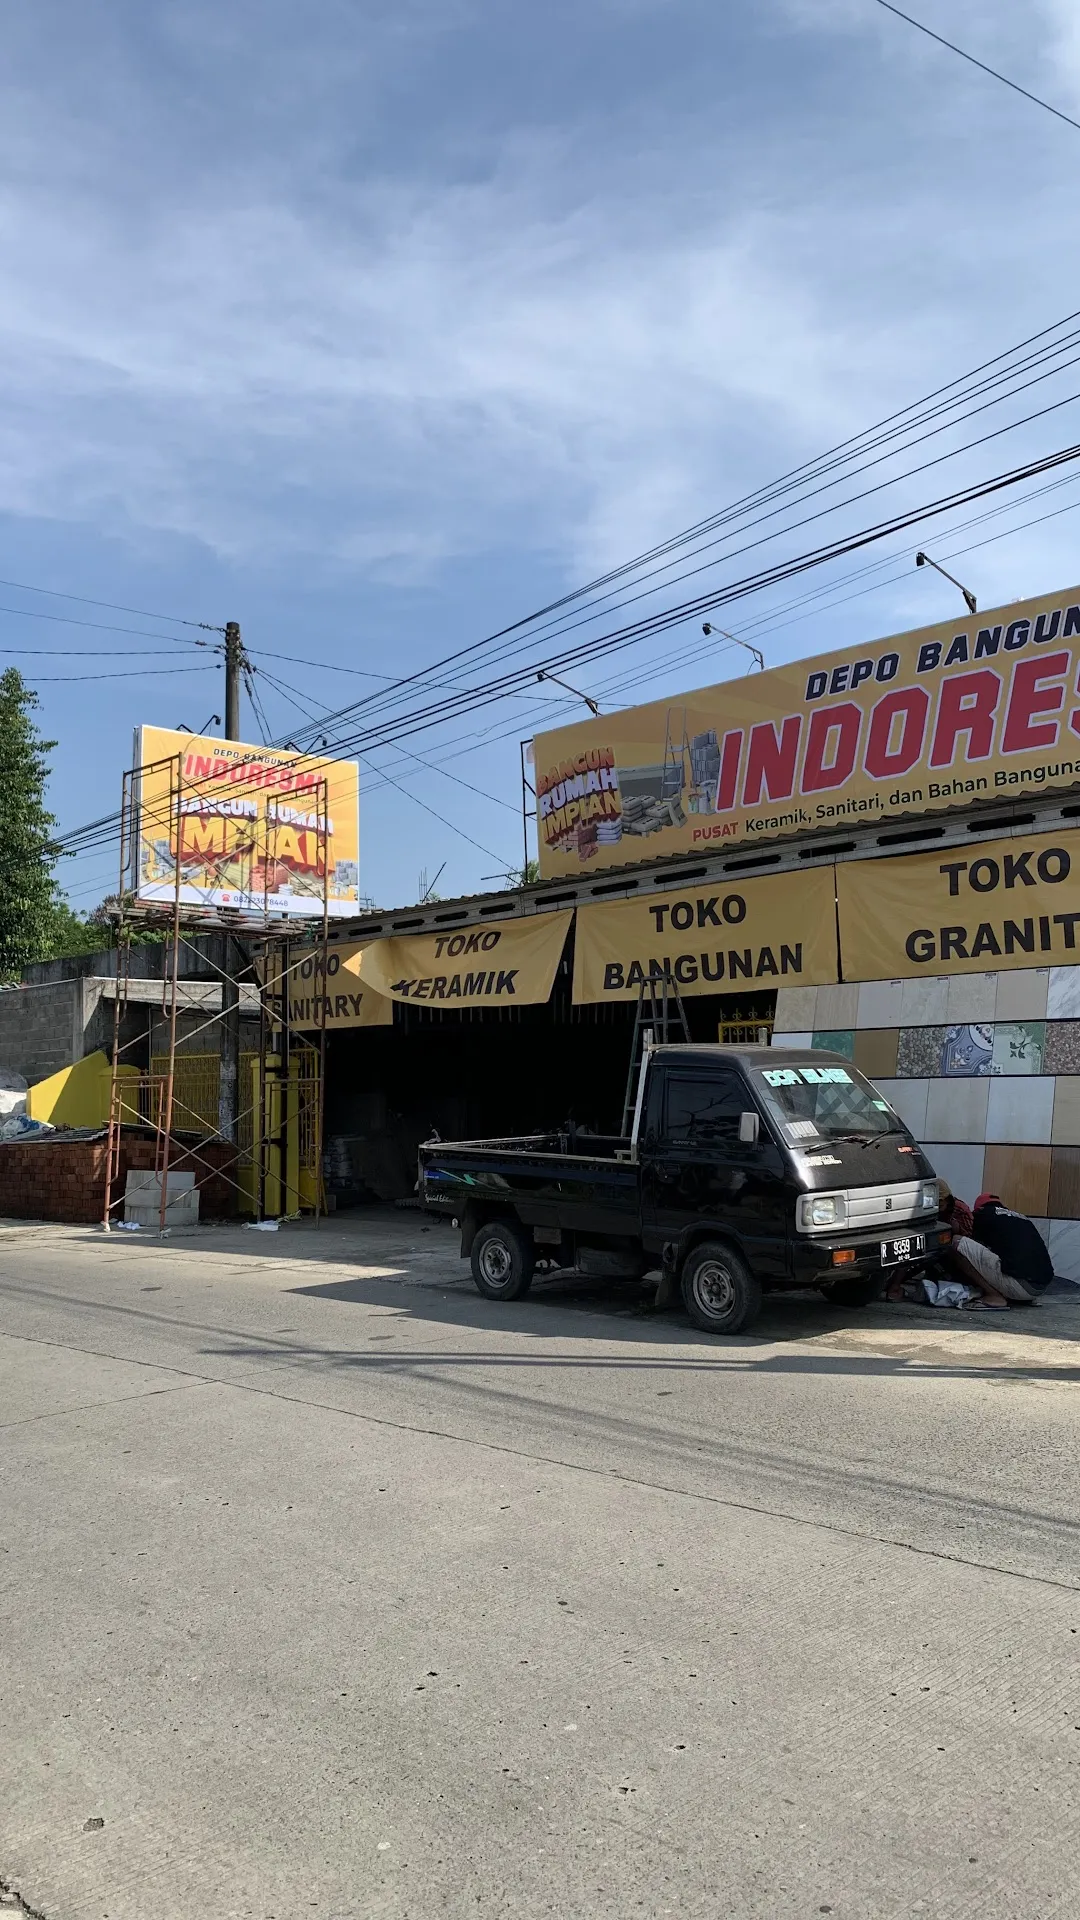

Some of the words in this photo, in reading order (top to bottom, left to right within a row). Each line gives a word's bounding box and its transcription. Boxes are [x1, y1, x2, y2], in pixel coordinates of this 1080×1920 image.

[805, 653, 899, 701] DEPO
[213, 748, 240, 759] DEPO
[715, 650, 1080, 813] INDORE
[537, 746, 615, 798] BANGUN
[540, 768, 619, 820] RUMAH
[542, 790, 622, 843] IMPIAN
[693, 822, 739, 842] PUSAT
[745, 808, 812, 833] Keramik,
[816, 793, 884, 819] Sanitari,
[889, 790, 923, 806] dan
[929, 779, 987, 799] Bahan
[939, 848, 1071, 896] TOKO
[649, 894, 746, 932] TOKO
[435, 931, 502, 958] TOKO
[906, 913, 1080, 963] GRANIT
[291, 953, 340, 980] TOKO
[390, 970, 520, 999] KERAMIK
[603, 943, 803, 989] BANGUNAN
[762, 1069, 803, 1087] DOA
[882, 1243, 888, 1258] R
[893, 1239, 910, 1255] 9359
